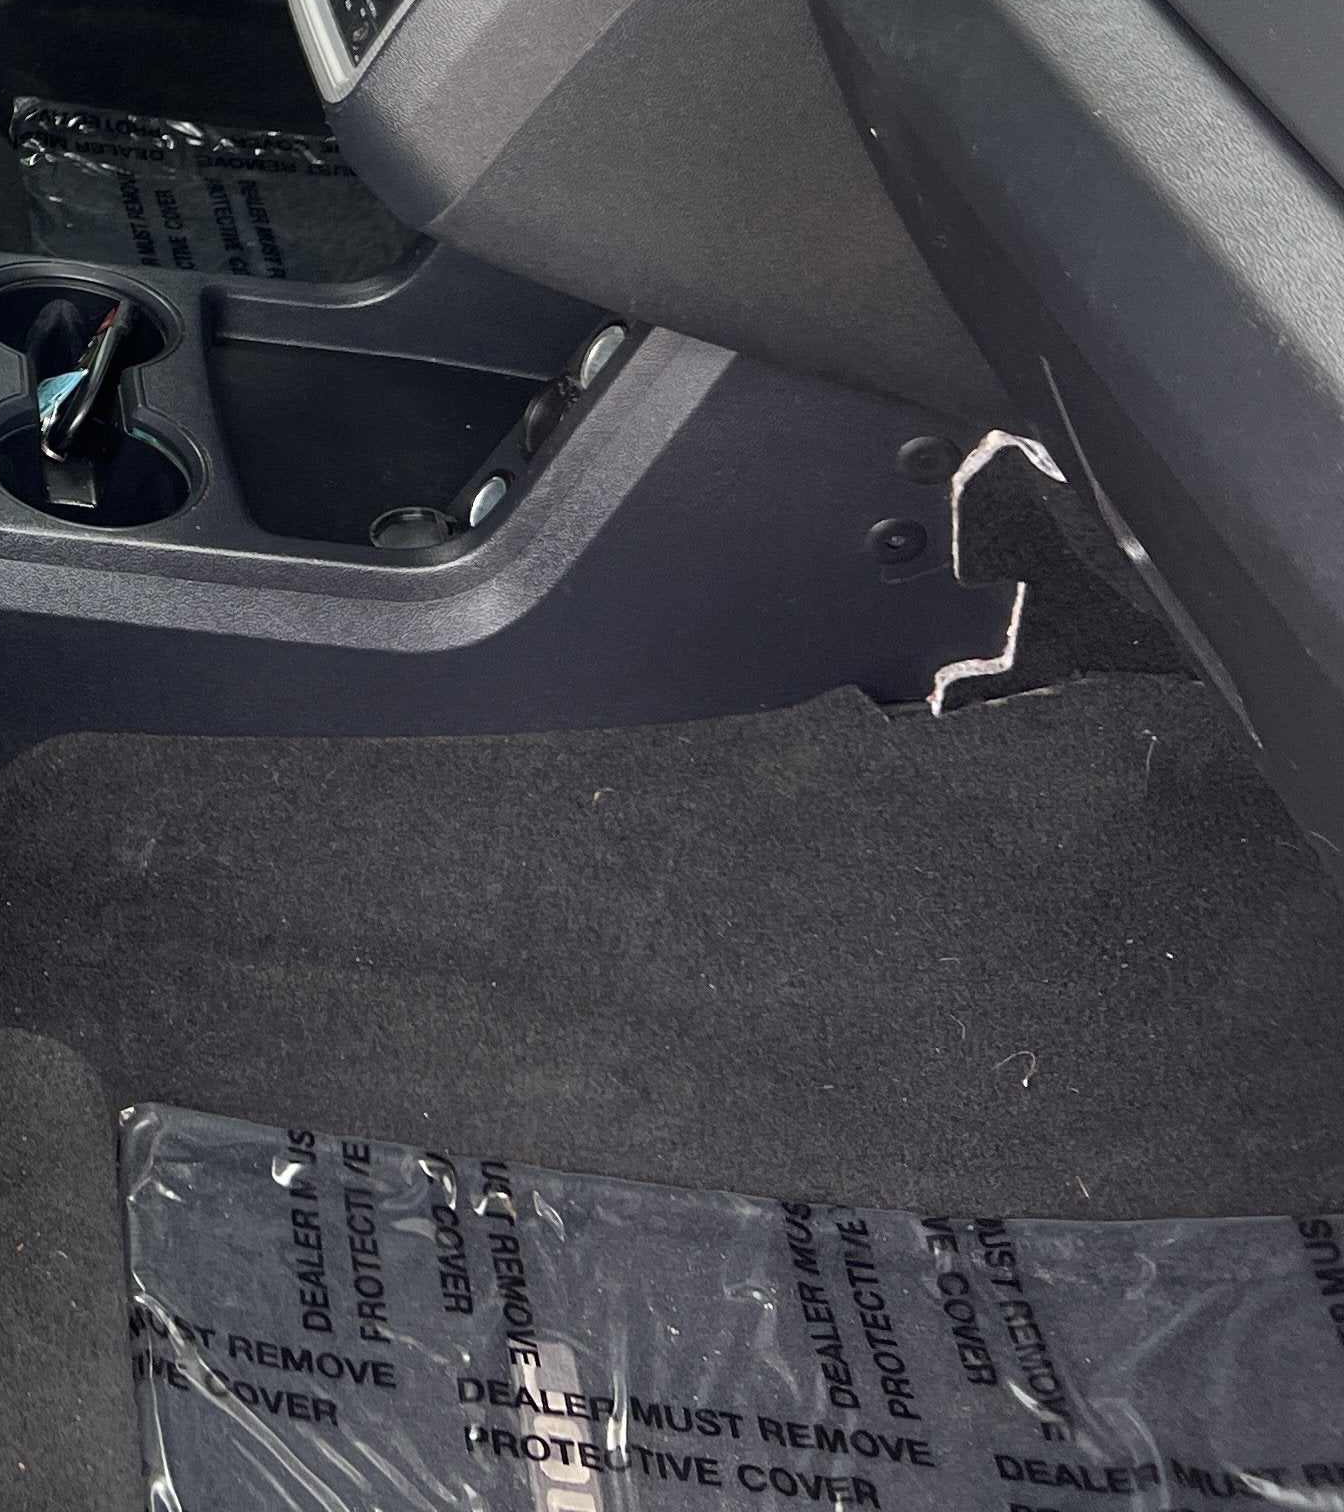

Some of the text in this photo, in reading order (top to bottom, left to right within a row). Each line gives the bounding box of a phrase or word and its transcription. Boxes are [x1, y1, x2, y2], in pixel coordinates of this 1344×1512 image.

[291, 1208, 333, 1333] DEALER
[432, 1205, 473, 1315] COVER
[489, 1233, 542, 1368] REMOVE
[228, 1336, 397, 1389] REMOVE
[798, 1281, 861, 1409] DEALER
[835, 1220, 922, 1421] PROTECTIVE
[936, 1271, 998, 1385] COVER
[204, 1368, 338, 1427] COVER
[457, 1377, 936, 1469] DEALER MUST REMOVE
[465, 1425, 882, 1510] PROTECTIVE COVER
[994, 1452, 1160, 1494] DEALER
